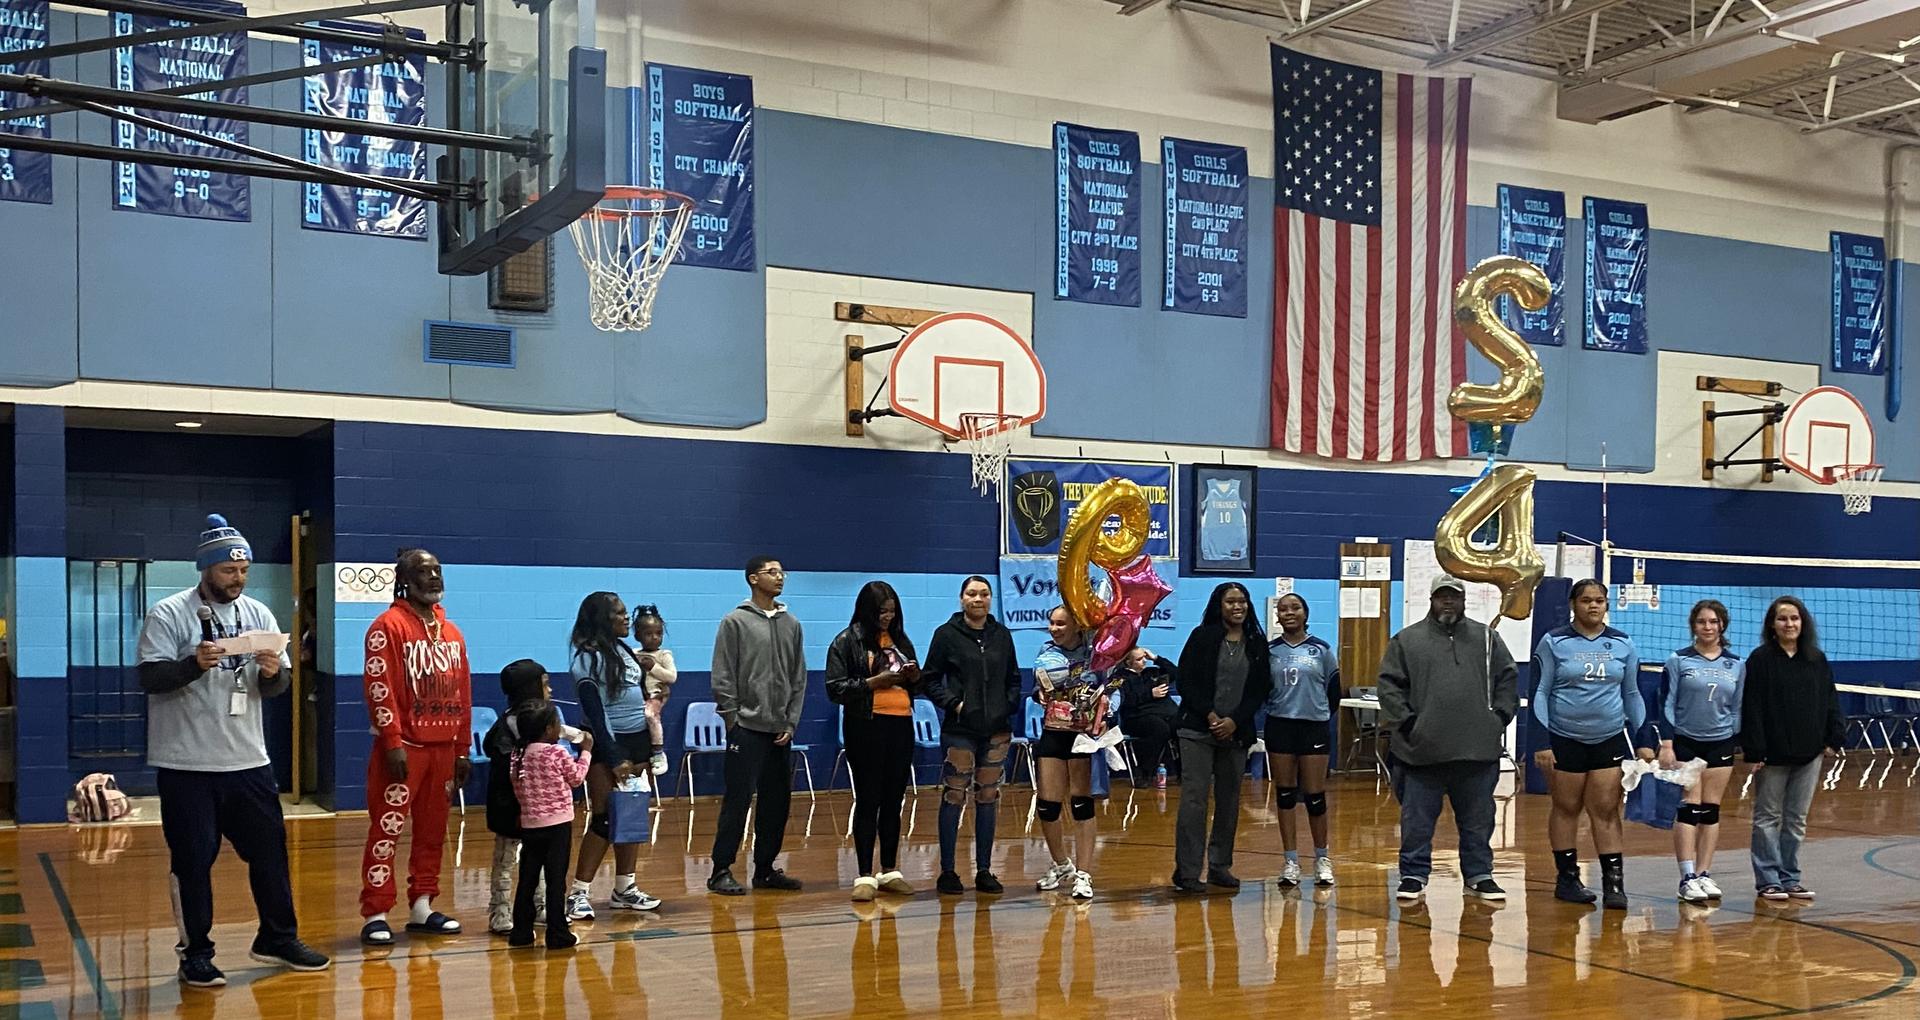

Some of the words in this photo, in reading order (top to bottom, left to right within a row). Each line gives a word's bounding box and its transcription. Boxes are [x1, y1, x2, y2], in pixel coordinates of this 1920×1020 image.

[159, 56, 224, 80] NATIONAL
[693, 83, 725, 101] BOYS
[674, 99, 745, 122] SOFTBALL
[333, 145, 360, 164] CITY
[1088, 140, 1120, 156] GIRLS
[674, 155, 699, 173] CITY
[703, 158, 745, 177] CHAMPS
[1077, 154, 1133, 175] SOFTBALL
[1193, 154, 1227, 171] GIRLS
[1182, 168, 1240, 188] SOFTBALL
[1083, 181, 1128, 198] NATIONAL
[1088, 198, 1124, 216] LEAGUE
[1178, 199, 1214, 216] NATIONAL
[1214, 203, 1244, 219] LEAGUE
[1524, 199, 1550, 213] GIRLS
[691, 215, 729, 233] 2000
[1096, 217, 1116, 231] AND
[1205, 218, 1229, 233] PLACE
[1511, 208, 1564, 230] BASKETBALL
[1608, 211, 1633, 225] GIRLS
[1071, 230, 1092, 244] CITY
[1111, 235, 1138, 250] PLACE
[1202, 232, 1219, 245] AND
[1182, 244, 1199, 258] CITY
[1214, 247, 1239, 262] PLACE
[1062, 482, 1081, 501] THE
[1219, 511, 1231, 524] 10
[1282, 667, 1298, 686] 13
[1584, 662, 1606, 681] 24
[1707, 682, 1718, 702] 7
